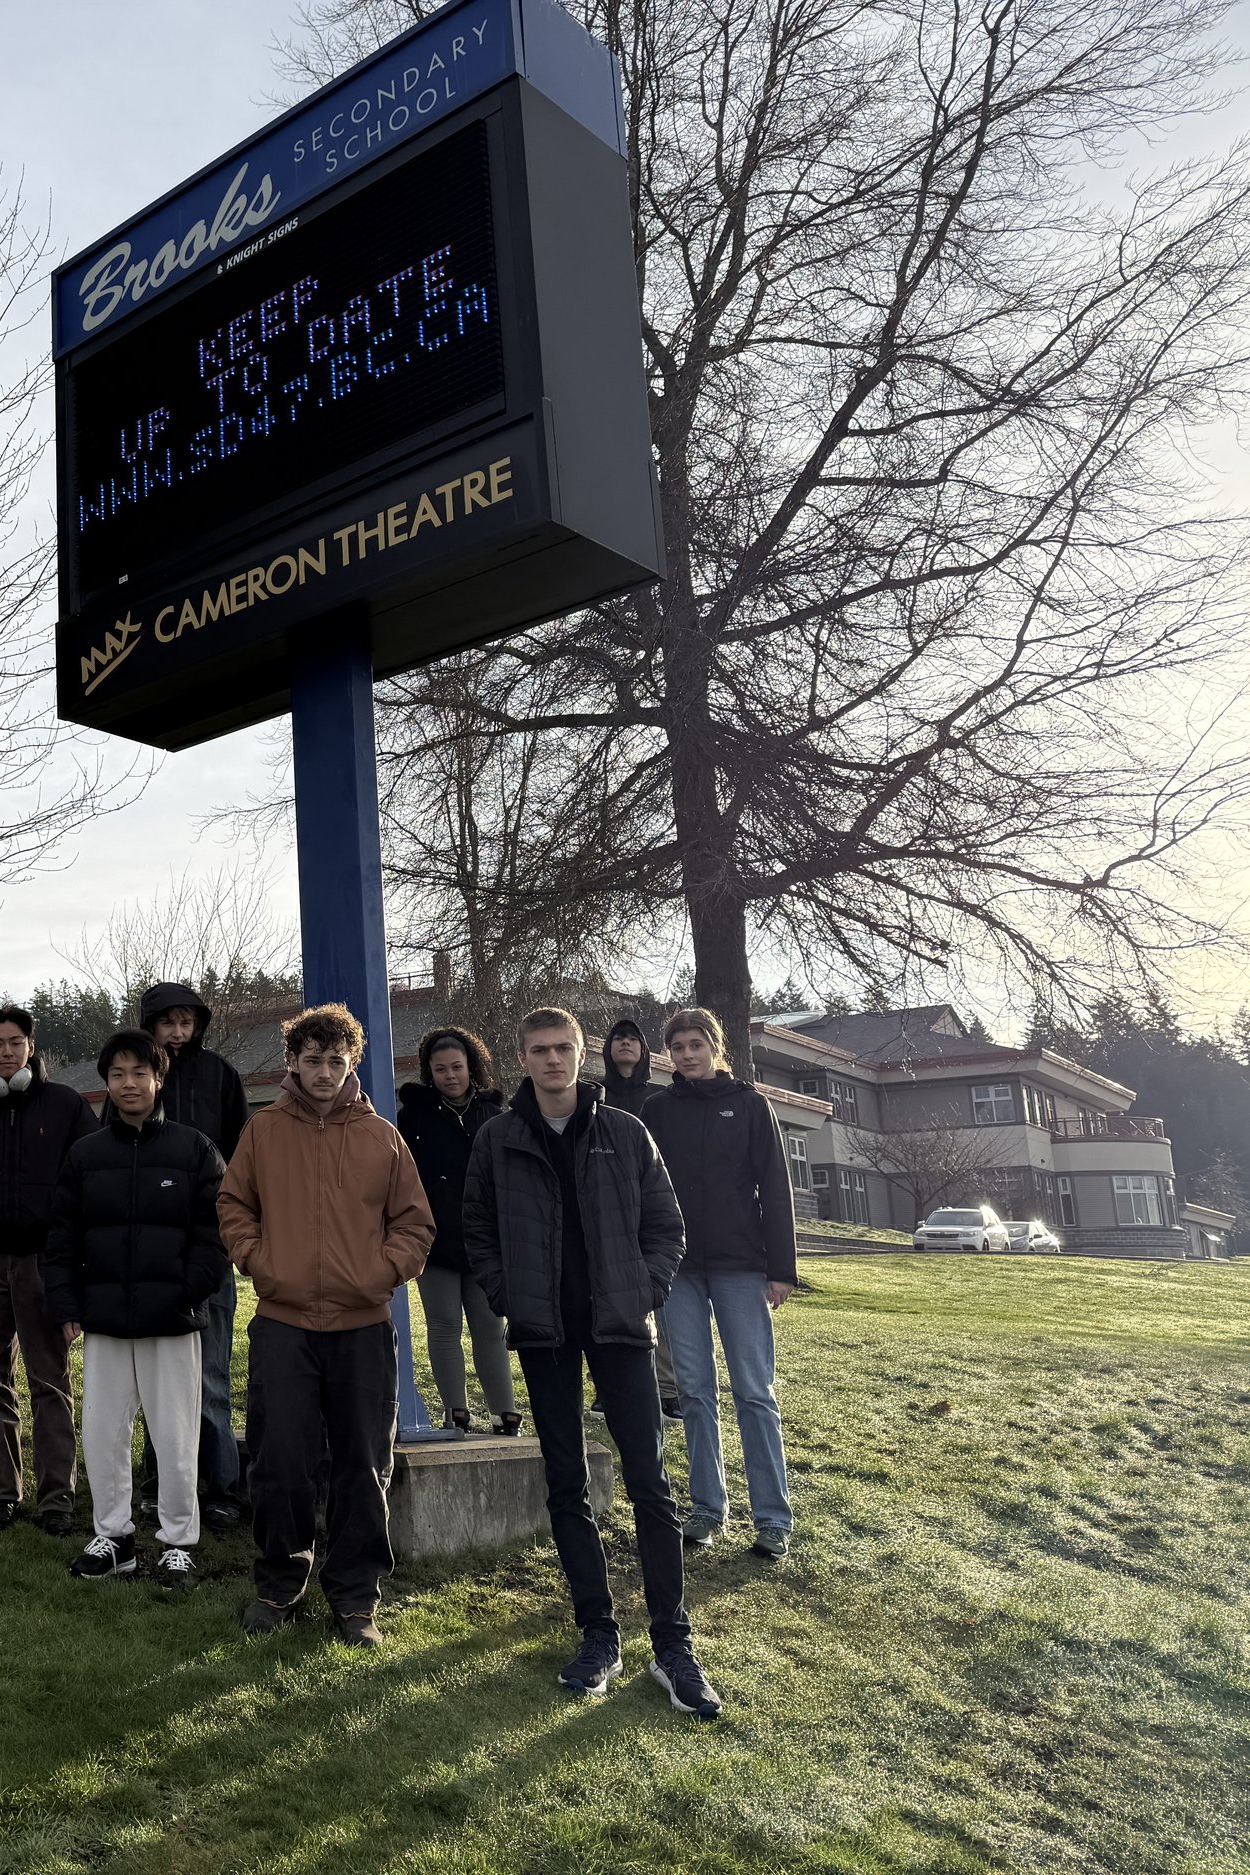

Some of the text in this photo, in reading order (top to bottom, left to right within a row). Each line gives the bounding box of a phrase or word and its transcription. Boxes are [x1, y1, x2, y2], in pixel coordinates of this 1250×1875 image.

[293, 20, 488, 163] SECONDARY
[325, 84, 457, 174] SCHOOL
[79, 162, 281, 332] Brooks
[226, 217, 299, 270] KNIGHT SIGNS
[120, 245, 454, 463] UP TO DATE
[199, 275, 318, 377] KEEP
[80, 456, 514, 684] MAX CAMERON THEATRE
